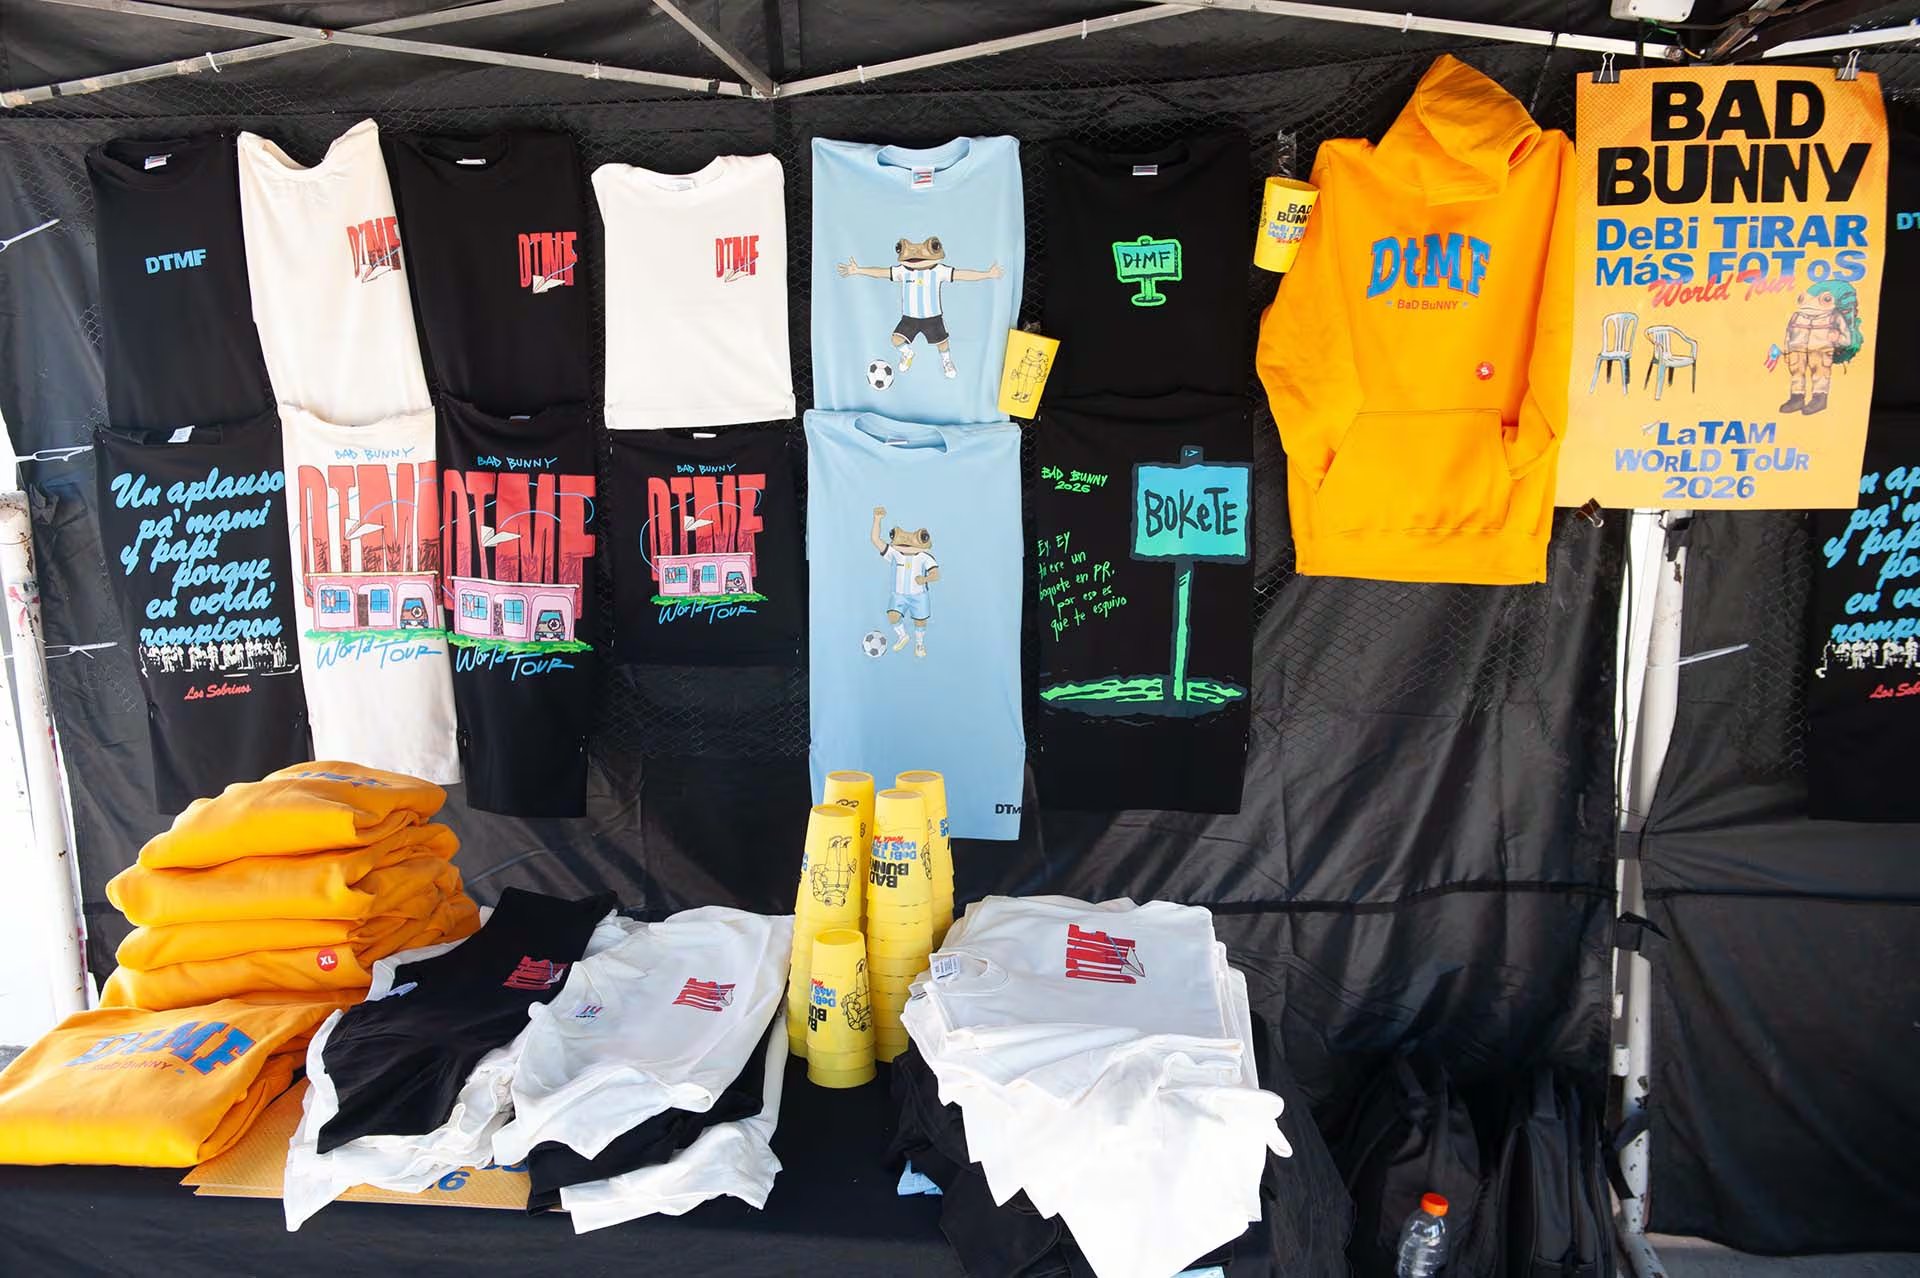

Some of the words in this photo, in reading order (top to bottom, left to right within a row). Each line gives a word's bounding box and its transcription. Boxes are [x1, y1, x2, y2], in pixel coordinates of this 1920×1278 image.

[1651, 79, 1826, 141] BAD
[1597, 143, 1872, 206] BUNNY
[1288, 203, 1312, 214] BAD
[1596, 216, 1699, 251] DeBi
[1713, 214, 1868, 249] TiRAR
[145, 249, 207, 274] DTMF
[518, 231, 578, 288] DTMF
[715, 235, 760, 278] DTMF
[1366, 232, 1492, 299] DtMF
[1596, 252, 1694, 286] MáS
[1649, 273, 1731, 308] World
[1736, 269, 1795, 300] Tour
[1656, 420, 1776, 446] LaTAM
[335, 449, 358, 461] BAD
[364, 446, 416, 460] BUNNY
[477, 455, 502, 468] BAD
[506, 456, 558, 470] BUNNY
[676, 464, 695, 473] BAD
[698, 463, 737, 474] BUNNY
[1041, 465, 1064, 481] BAD
[1069, 469, 1109, 487] BUNNY
[110, 472, 162, 509] Un
[166, 466, 285, 512] aplauso
[1054, 480, 1091, 493] 2026
[1662, 475, 1755, 499] 2026
[185, 499, 272, 534] mami
[647, 473, 766, 582] DTMF
[150, 531, 222, 573] papi
[443, 468, 597, 620] DTMF
[171, 558, 272, 597] porque
[1075, 573, 1089, 584] en
[145, 599, 177, 619] en
[1092, 595, 1127, 618] esquivo
[1844, 590, 1881, 615] en
[140, 615, 283, 646] rompieron
[206, 682, 252, 698] Sobrinos
[869, 871, 898, 888] BAD
[319, 955, 336, 966] XL
